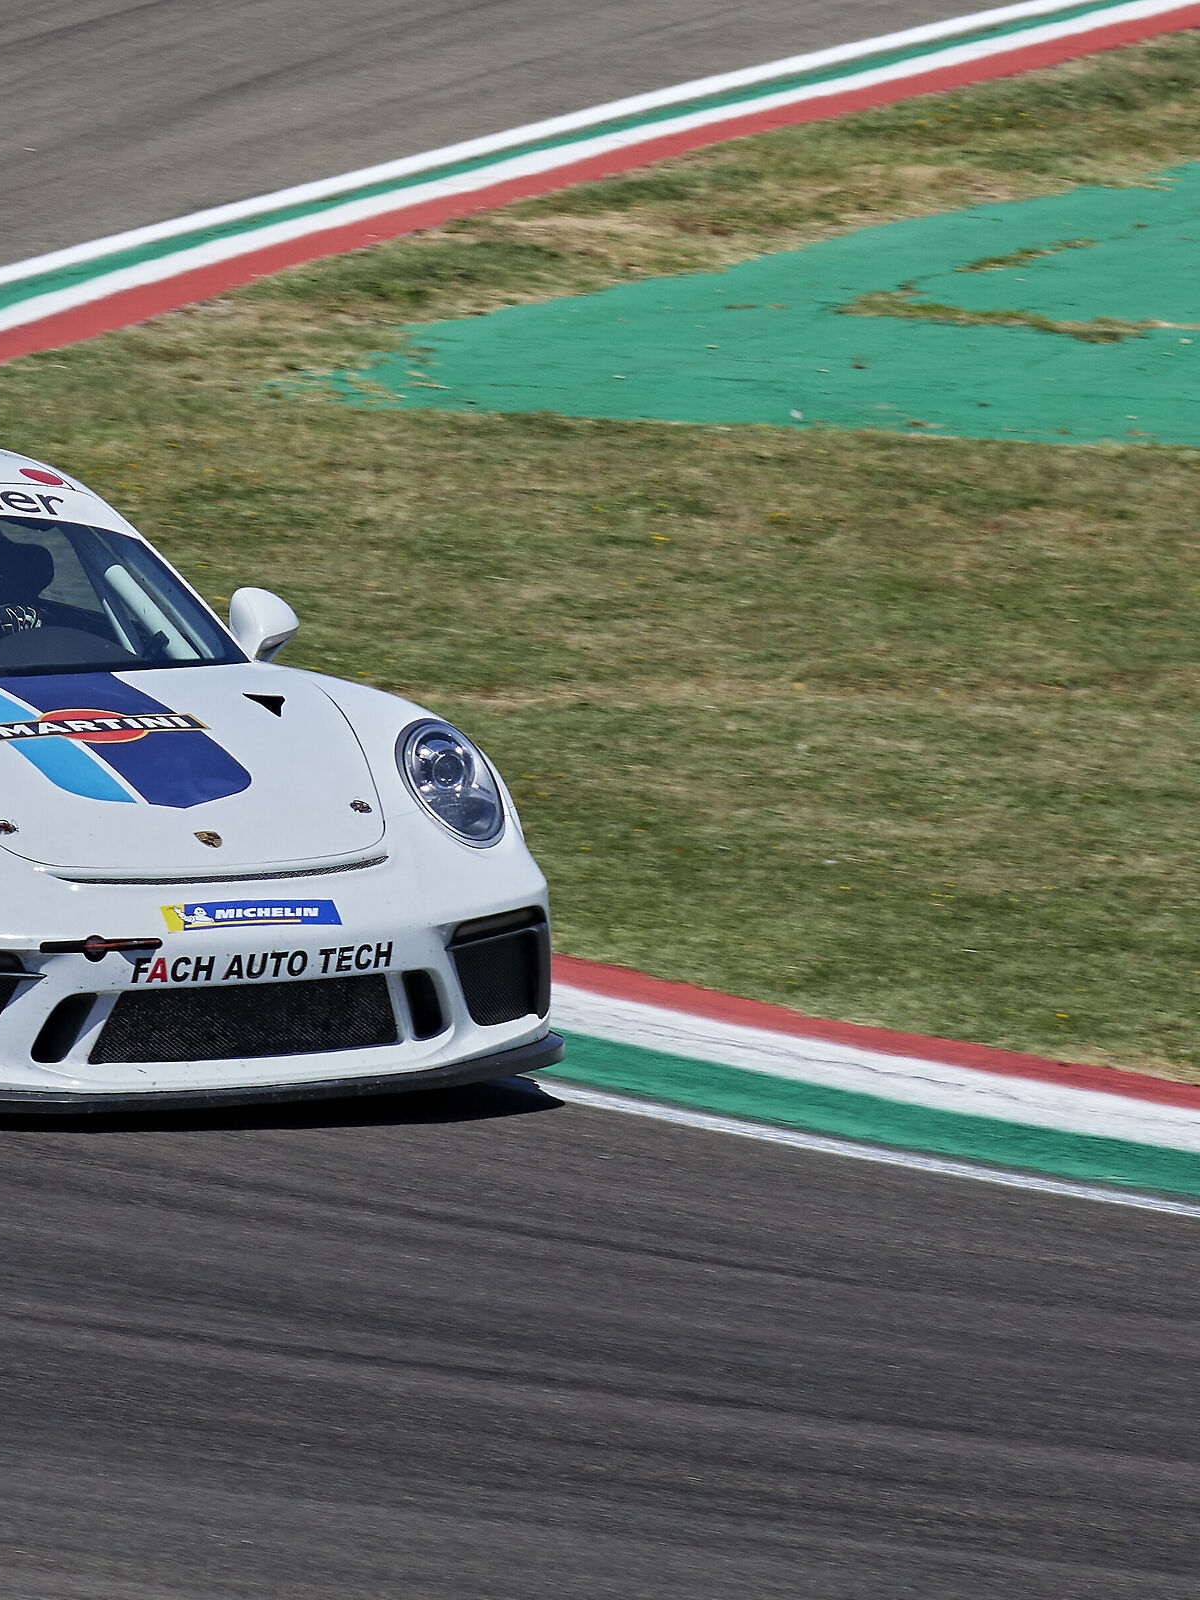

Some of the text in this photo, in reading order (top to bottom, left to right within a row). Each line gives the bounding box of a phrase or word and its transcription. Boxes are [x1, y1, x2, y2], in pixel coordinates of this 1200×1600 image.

[215, 907, 319, 920] MICHELIN
[131, 941, 394, 984] FACH AUTO TECH
